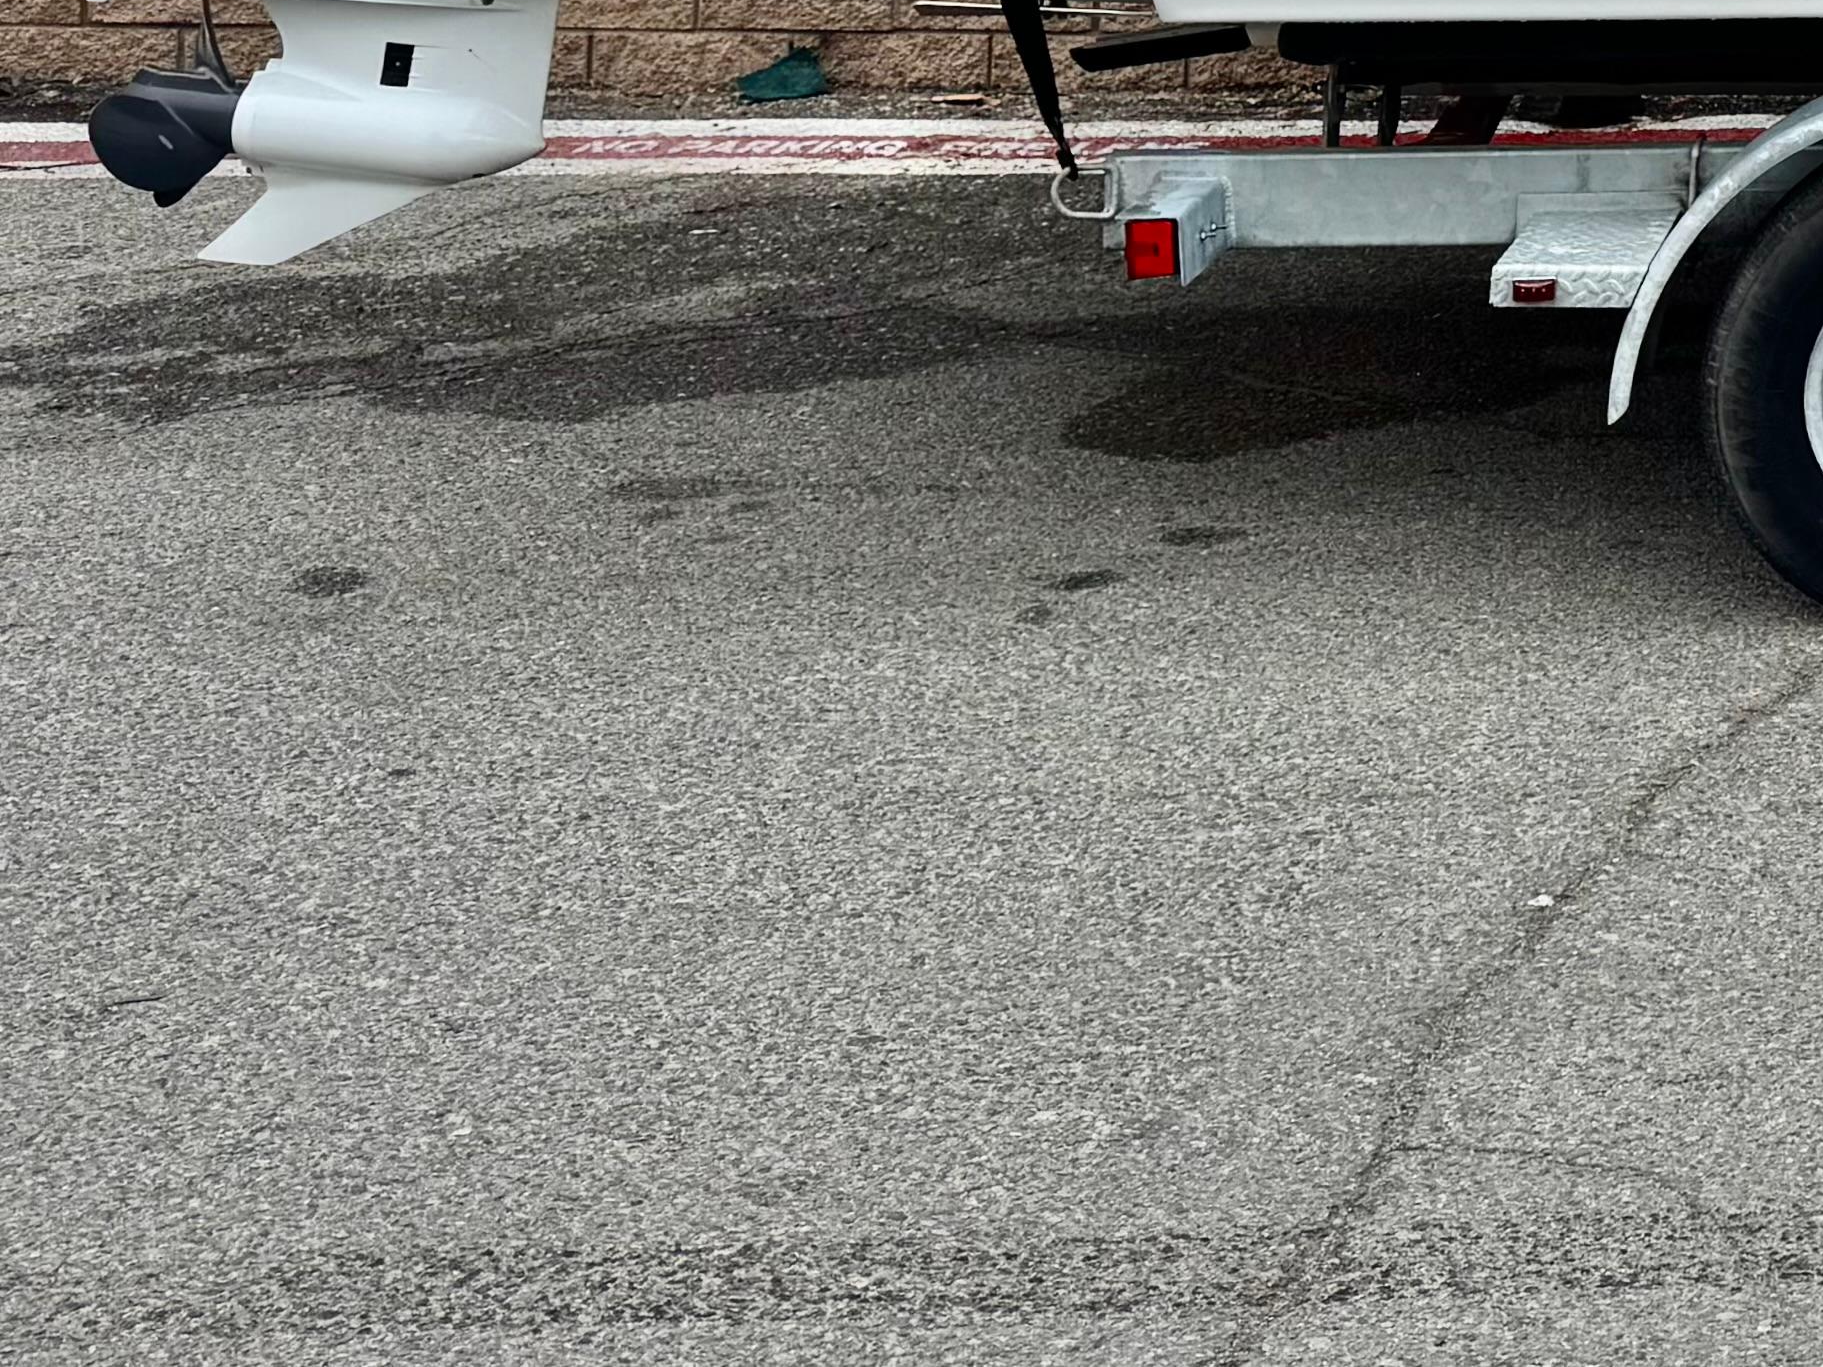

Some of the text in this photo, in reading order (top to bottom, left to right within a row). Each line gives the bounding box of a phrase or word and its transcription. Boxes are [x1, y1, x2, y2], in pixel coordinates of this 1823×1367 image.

[571, 140, 658, 154] NO
[667, 140, 906, 156] PARKING
[933, 141, 1056, 156] FIRE
